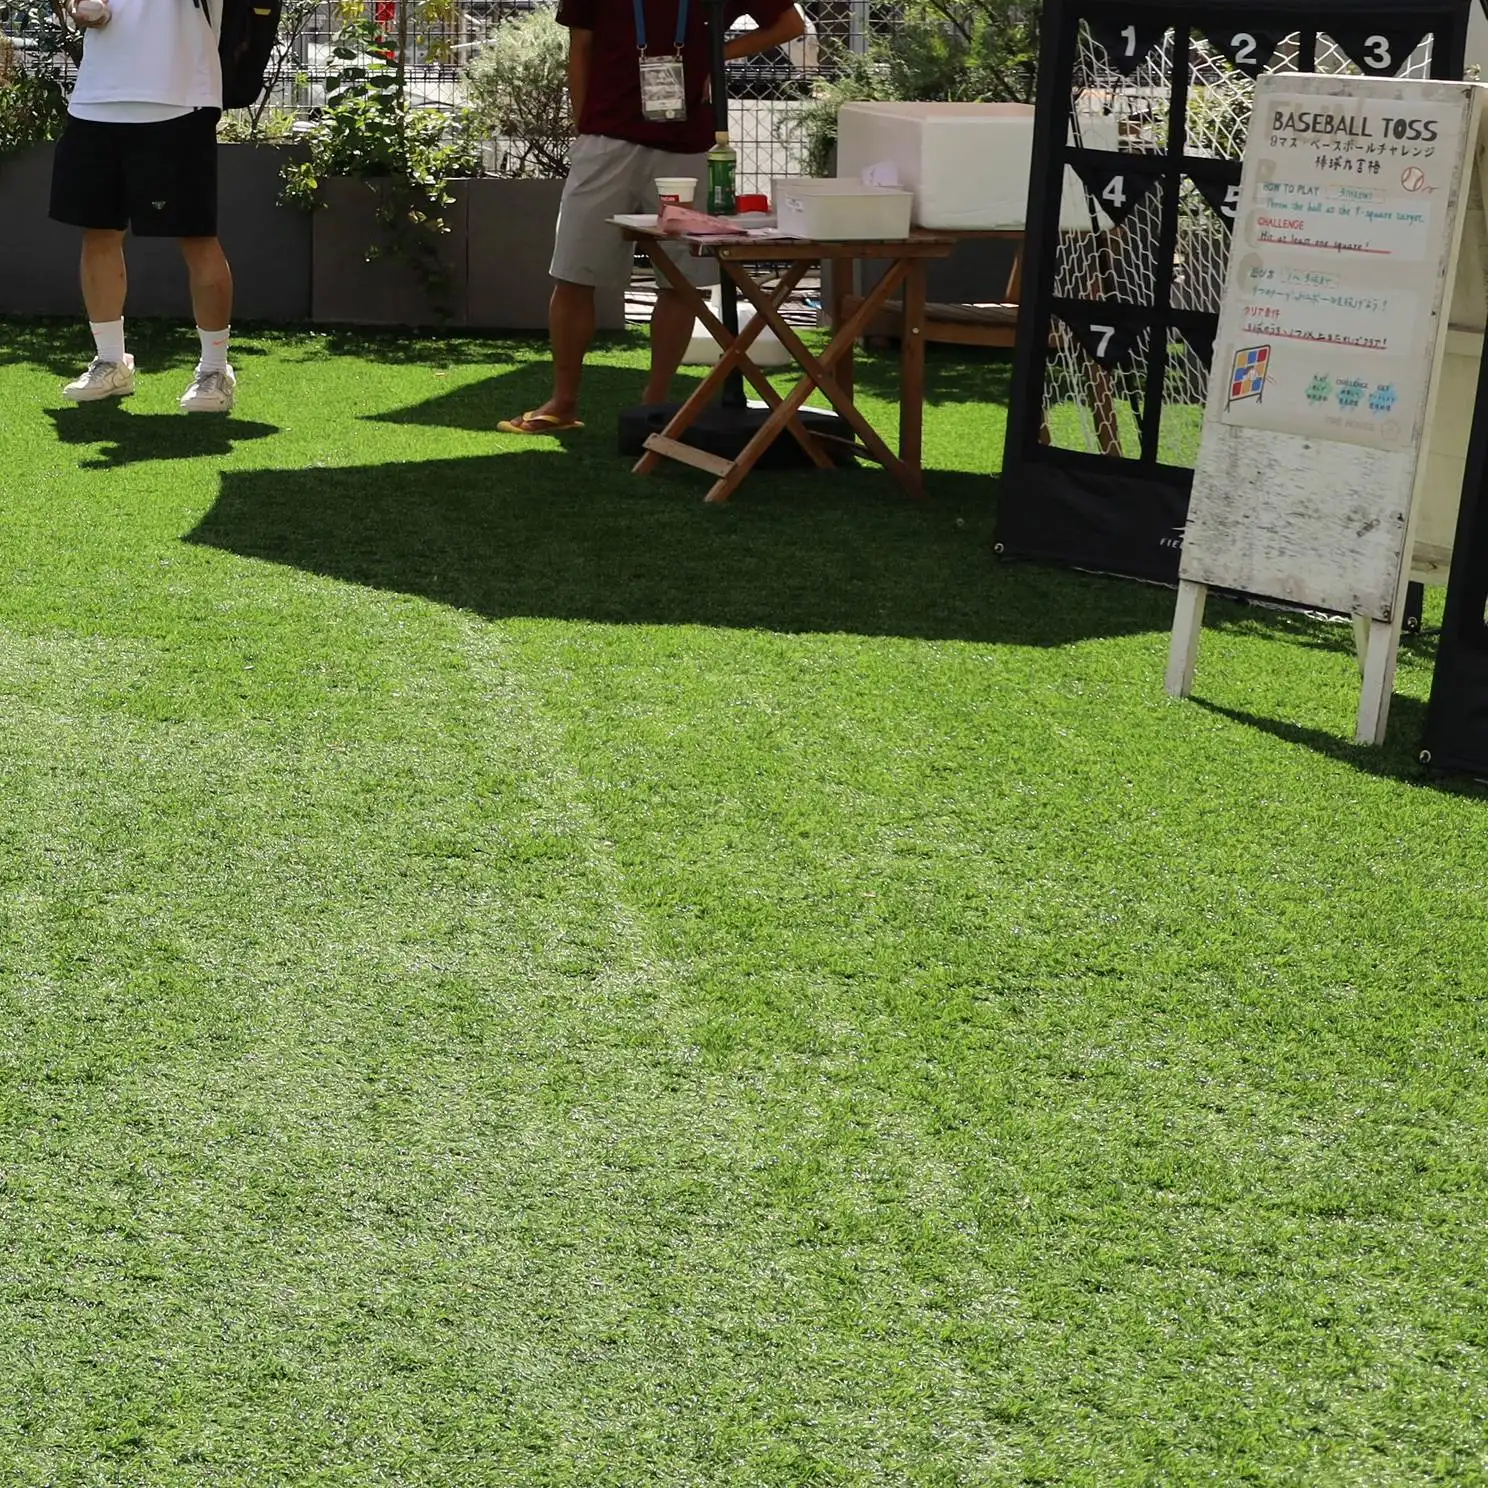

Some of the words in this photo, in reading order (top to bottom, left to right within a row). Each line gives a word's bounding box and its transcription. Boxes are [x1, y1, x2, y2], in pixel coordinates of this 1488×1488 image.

[1120, 25, 1136, 57] 1
[1230, 32, 1257, 65] 2
[1364, 35, 1392, 69] 3
[1272, 111, 1372, 138] BASEBALL
[1382, 118, 1439, 142] TOSS
[1102, 175, 1126, 207] 4
[1090, 325, 1115, 358] 7
[1159, 537, 1181, 549] FIE
